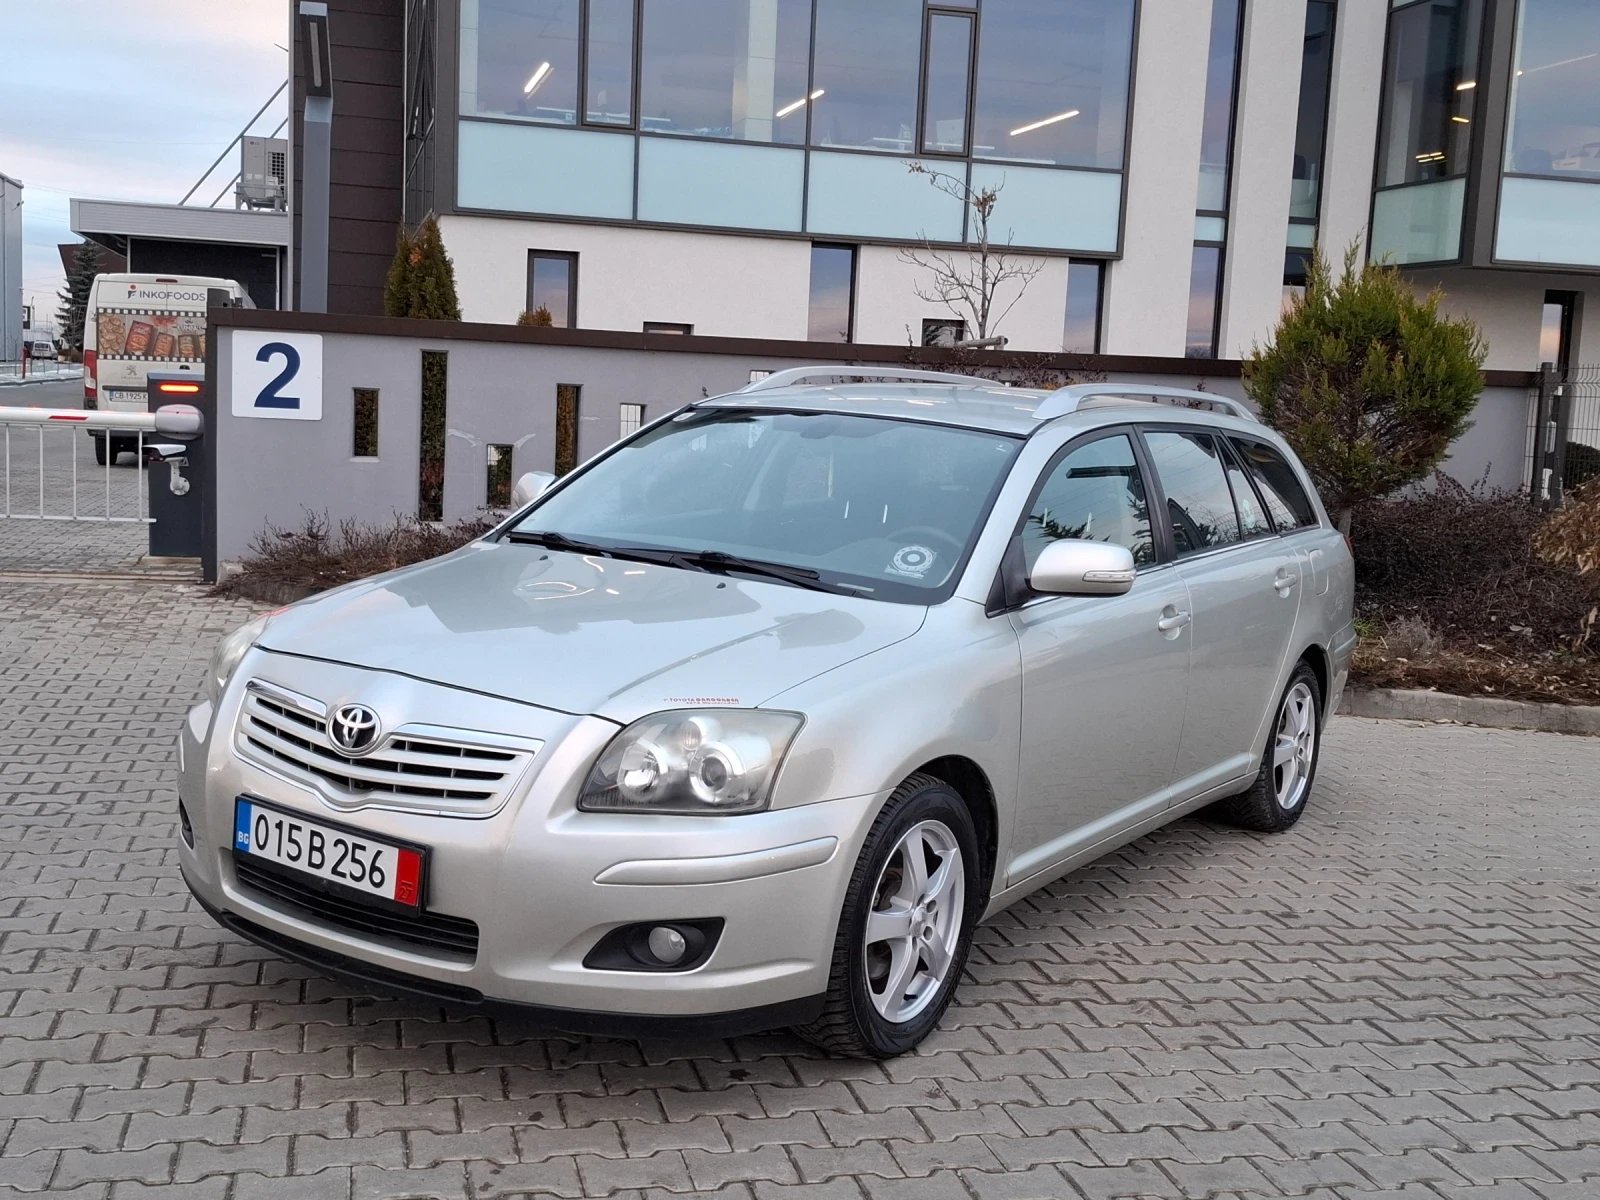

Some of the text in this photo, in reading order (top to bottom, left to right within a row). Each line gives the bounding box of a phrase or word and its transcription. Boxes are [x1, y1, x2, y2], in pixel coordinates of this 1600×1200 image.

[139, 290, 206, 301] INKOFOODS
[253, 342, 301, 410] 2
[238, 831, 249, 844] BG
[255, 813, 386, 889] 015B256
